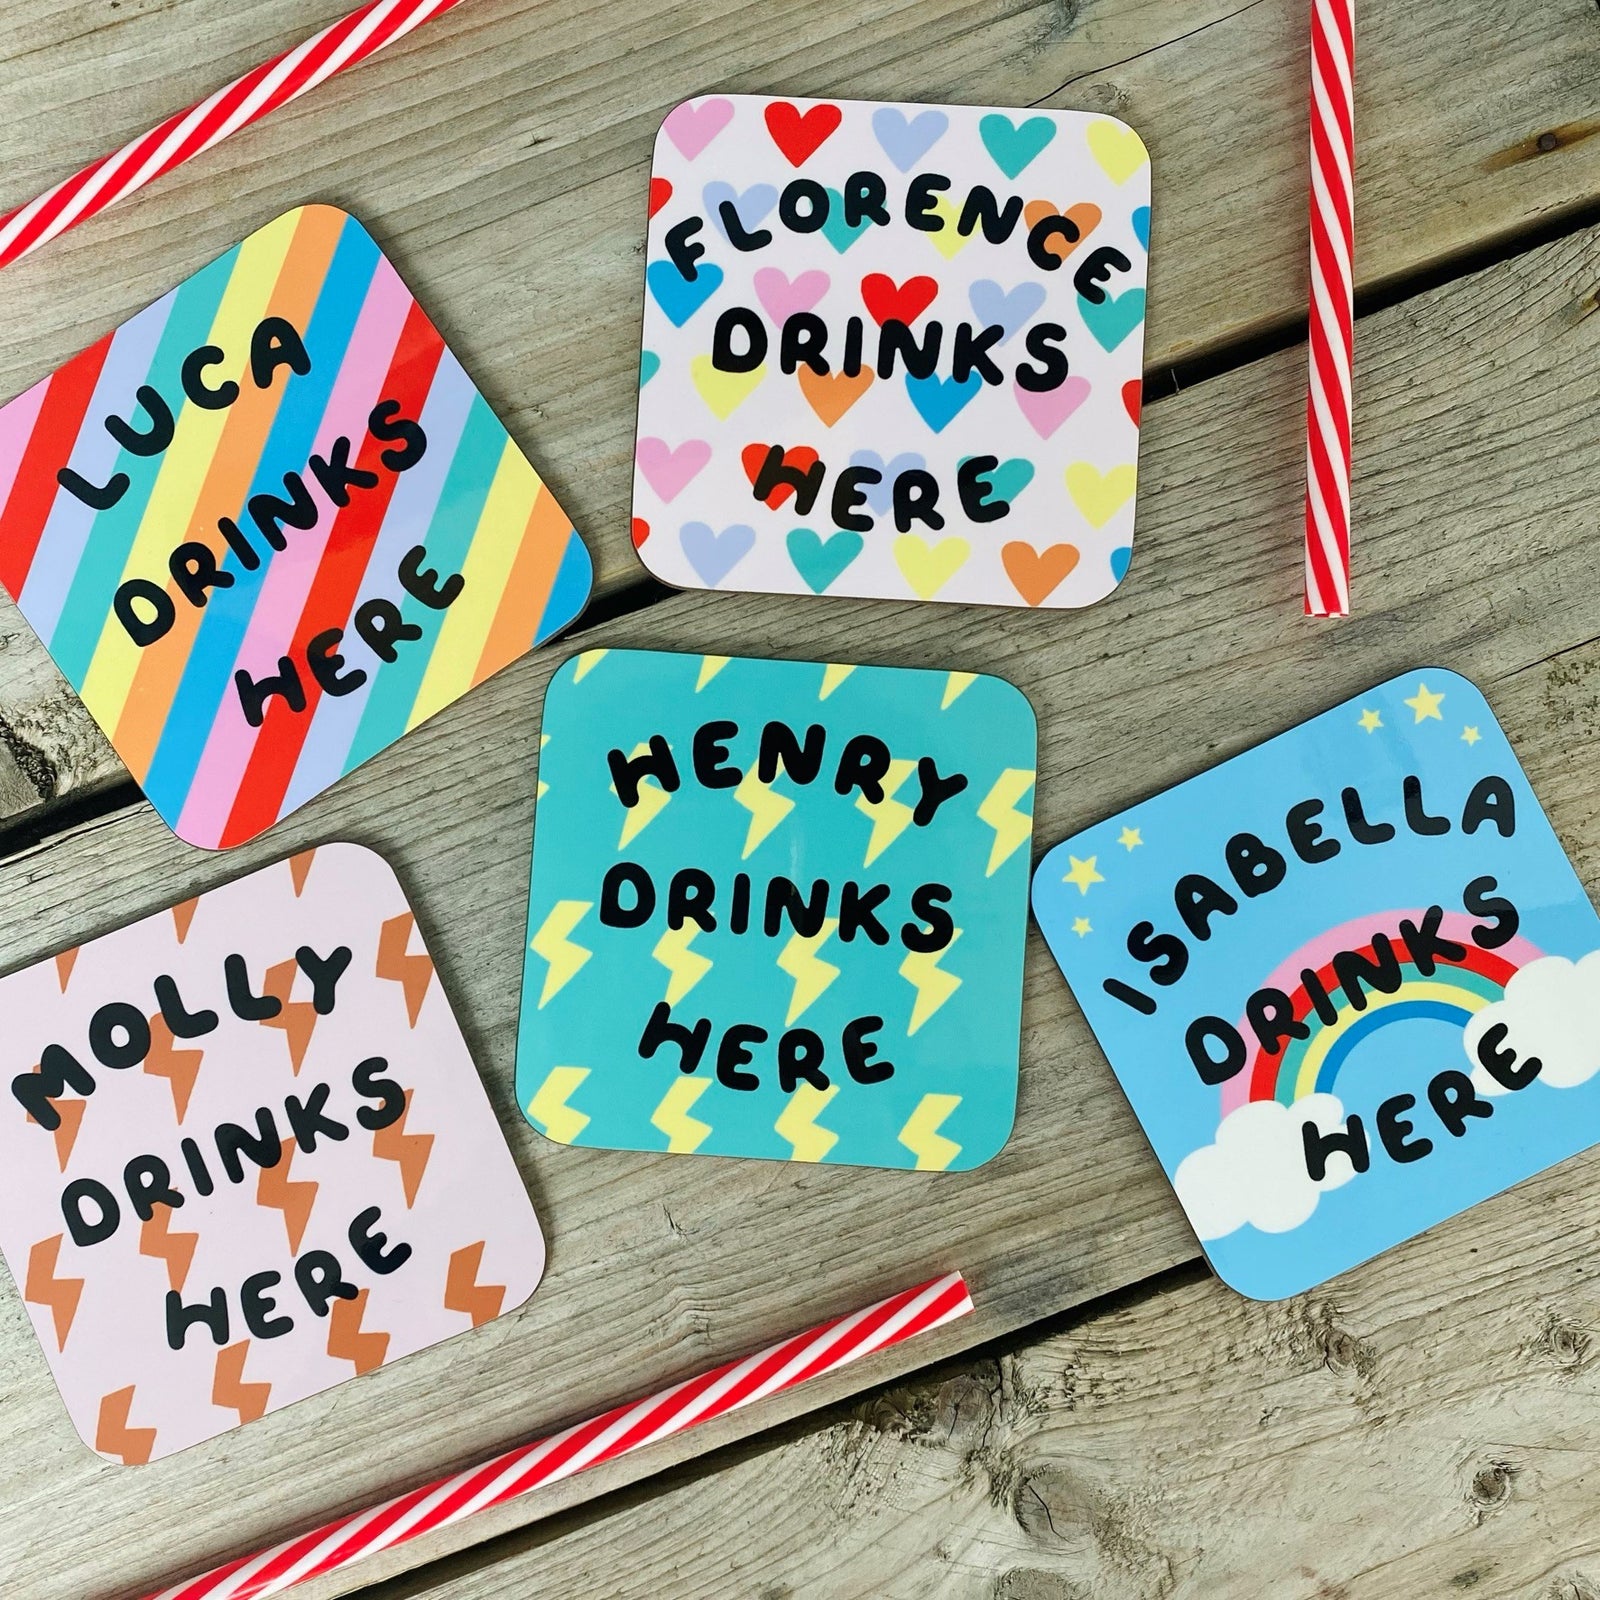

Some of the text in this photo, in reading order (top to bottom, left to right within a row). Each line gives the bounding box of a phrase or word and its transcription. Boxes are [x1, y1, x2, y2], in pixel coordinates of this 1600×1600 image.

[664, 171, 1132, 305] FLORENCE
[57, 316, 311, 511] LUCA
[712, 306, 1069, 393] DRINKS
[113, 399, 428, 648] DRINKS
[752, 444, 1010, 534] HERE
[234, 545, 465, 728] HERE
[607, 720, 967, 827] HENRY
[599, 862, 955, 954] DRINKS
[1103, 774, 1517, 1016] ISABELLA
[11, 945, 353, 1131] MOLLY
[638, 1001, 895, 1094] HERE
[1184, 874, 1520, 1087] DRINKS
[61, 1056, 409, 1247] DRINKS
[1301, 1022, 1543, 1182] HERE
[165, 1206, 413, 1350] HERE
